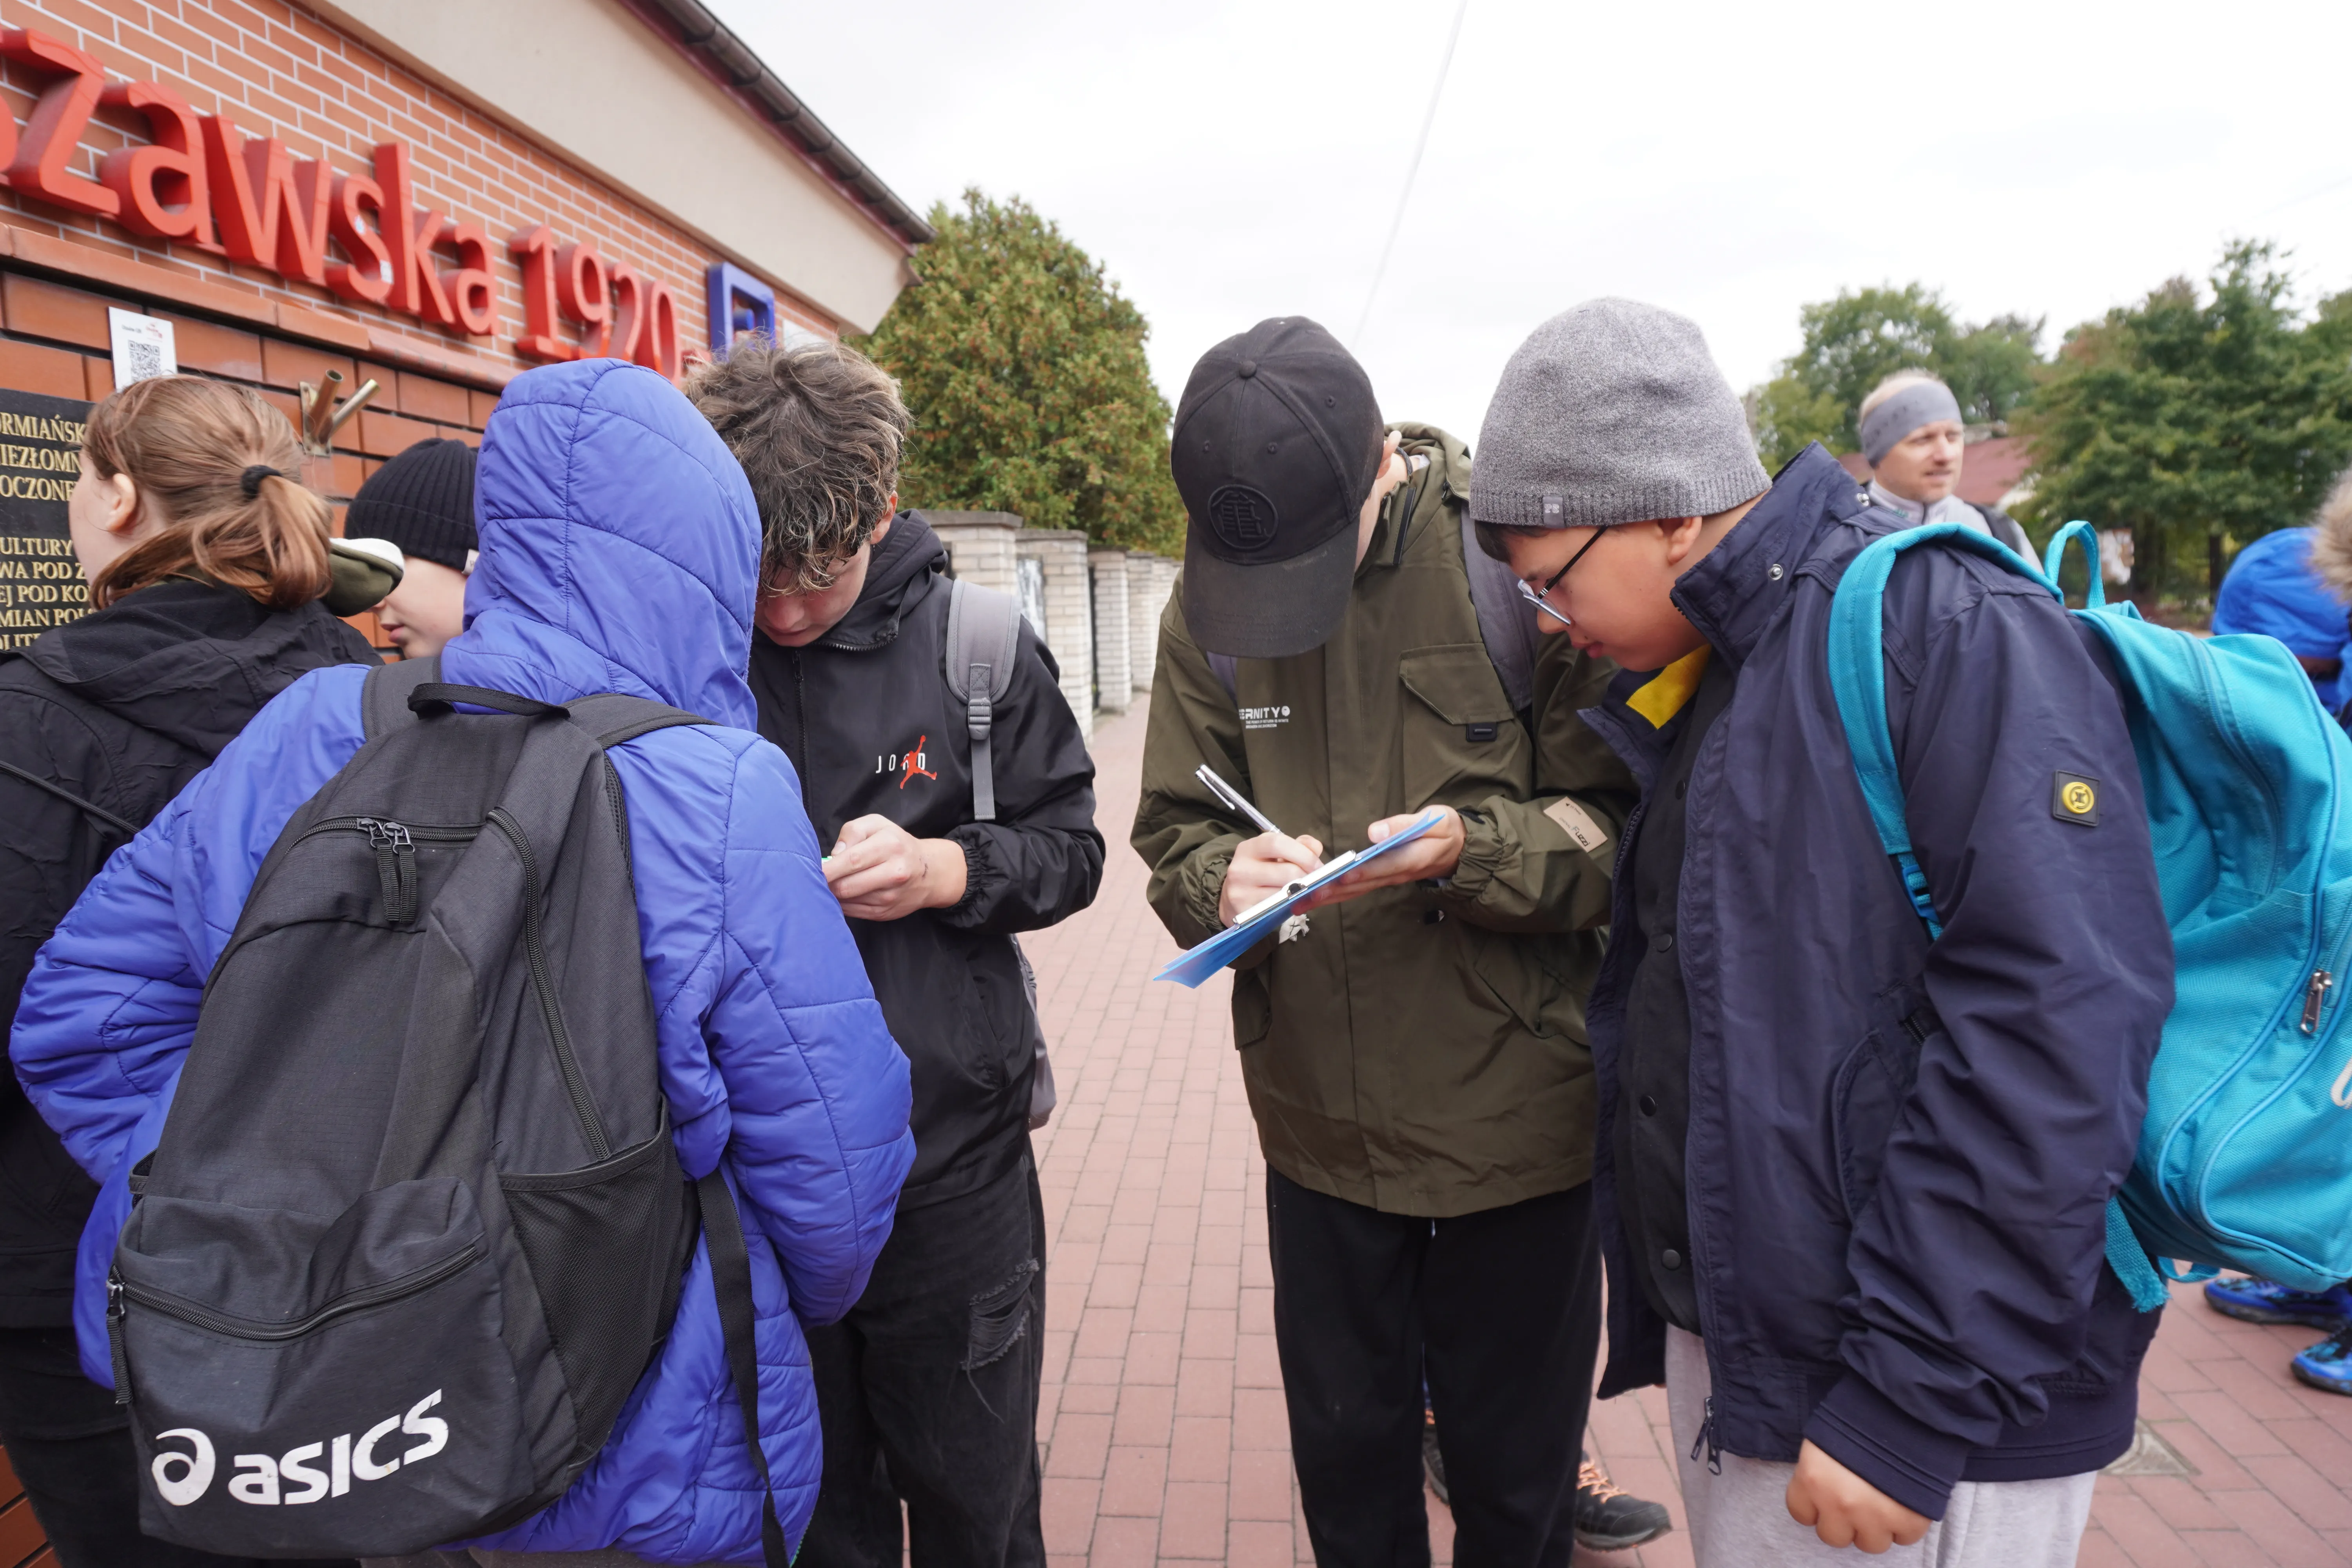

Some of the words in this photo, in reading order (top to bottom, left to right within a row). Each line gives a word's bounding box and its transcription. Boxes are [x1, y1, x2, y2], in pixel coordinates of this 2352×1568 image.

[0, 28, 499, 336] zawska
[510, 224, 682, 387] 1920
[0, 412, 85, 443] RMIAŃSK
[0, 444, 83, 473] IEZŁOMN
[0, 474, 78, 502] OCZONE
[0, 537, 73, 556] ULTURY
[0, 561, 30, 579] WA
[31, 561, 73, 579] POD
[75, 562, 87, 579] Z
[0, 584, 13, 608] EJ
[16, 584, 58, 603] POD
[60, 584, 91, 603] KO
[0, 609, 50, 627] MIAN
[228, 1388, 449, 1505] asics
